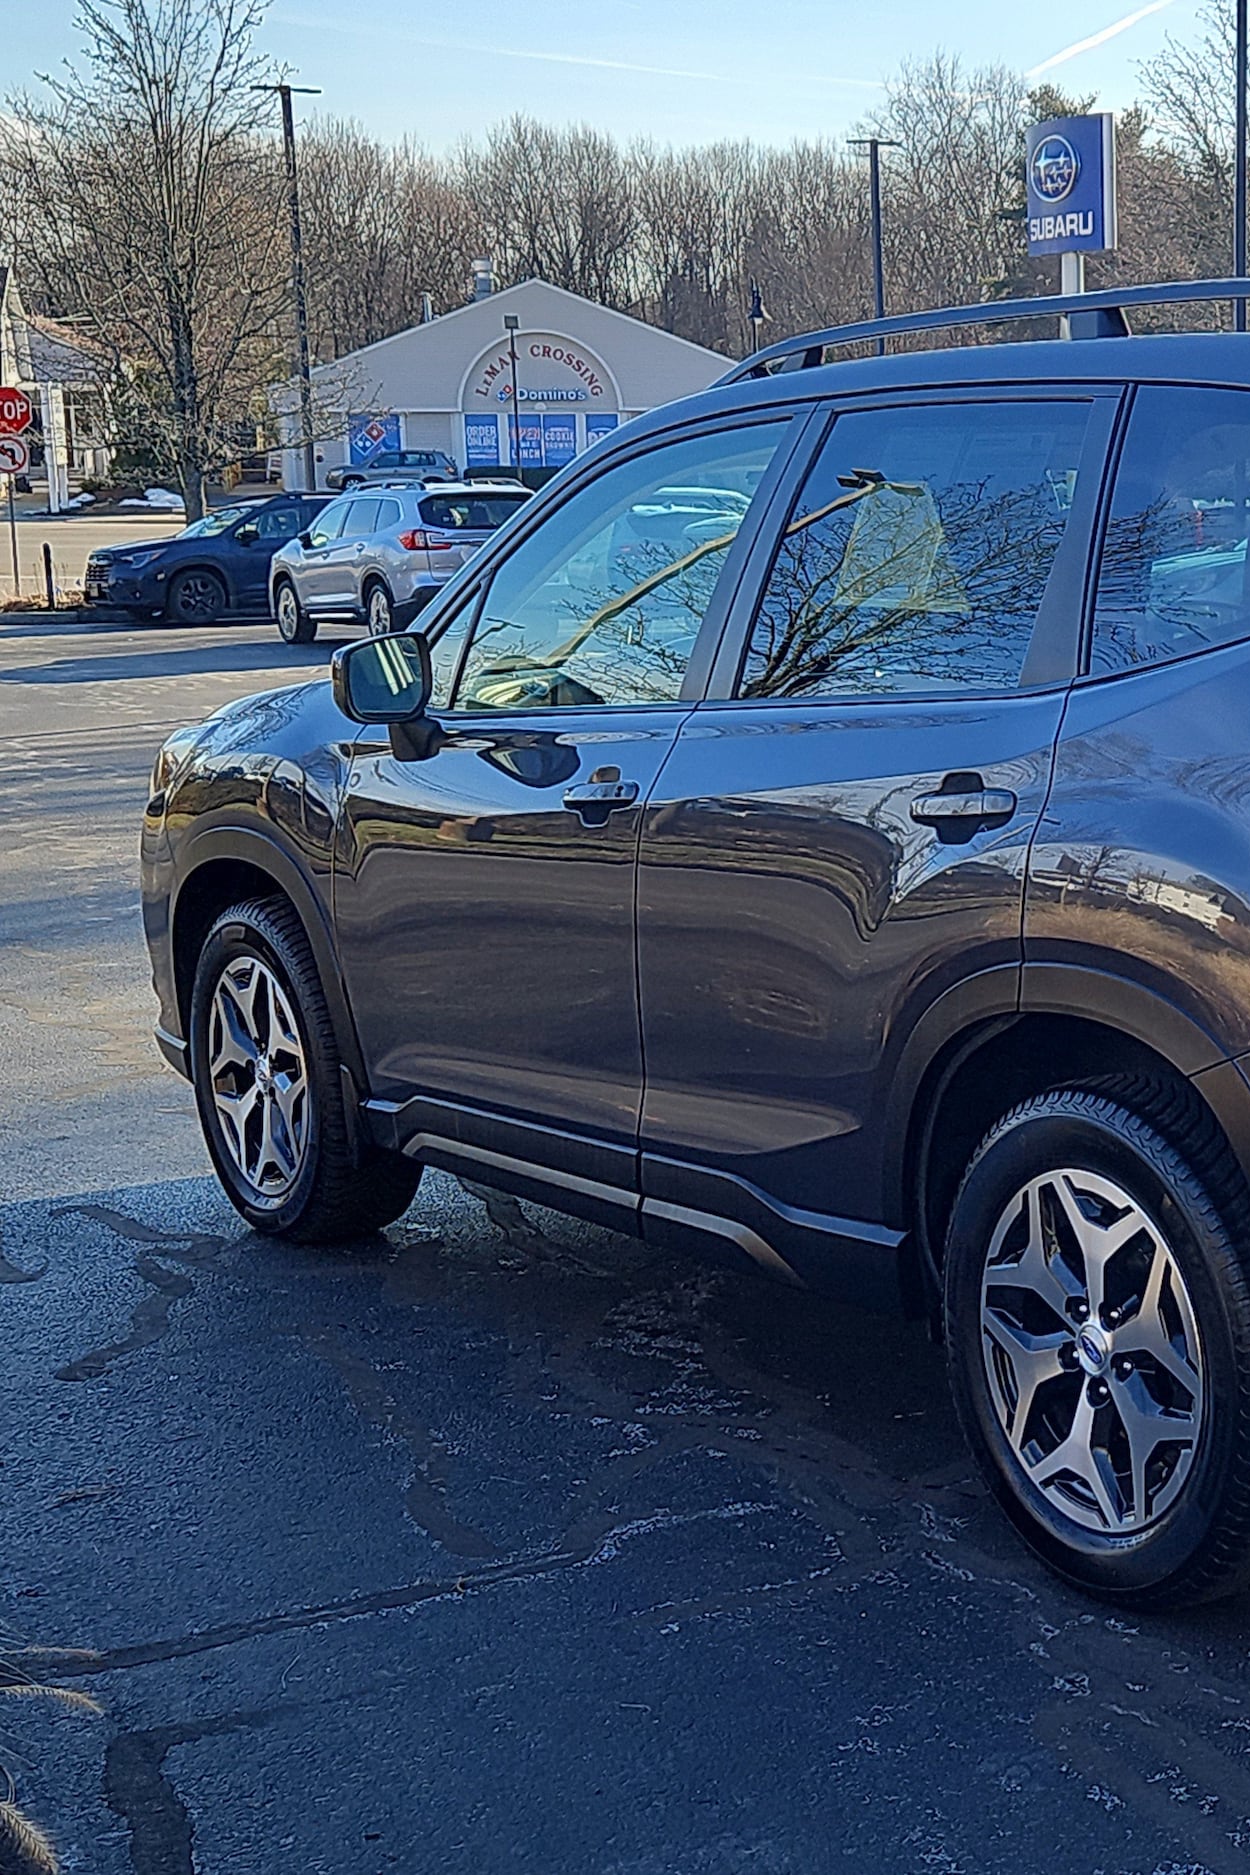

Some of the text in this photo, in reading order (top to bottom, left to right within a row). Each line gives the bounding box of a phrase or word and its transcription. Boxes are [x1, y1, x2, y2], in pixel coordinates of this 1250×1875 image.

[1030, 211, 1093, 241] SUBARU
[529, 344, 603, 397] CROSSING
[517, 388, 586, 400] Domino's
[466, 425, 497, 437] ORDER
